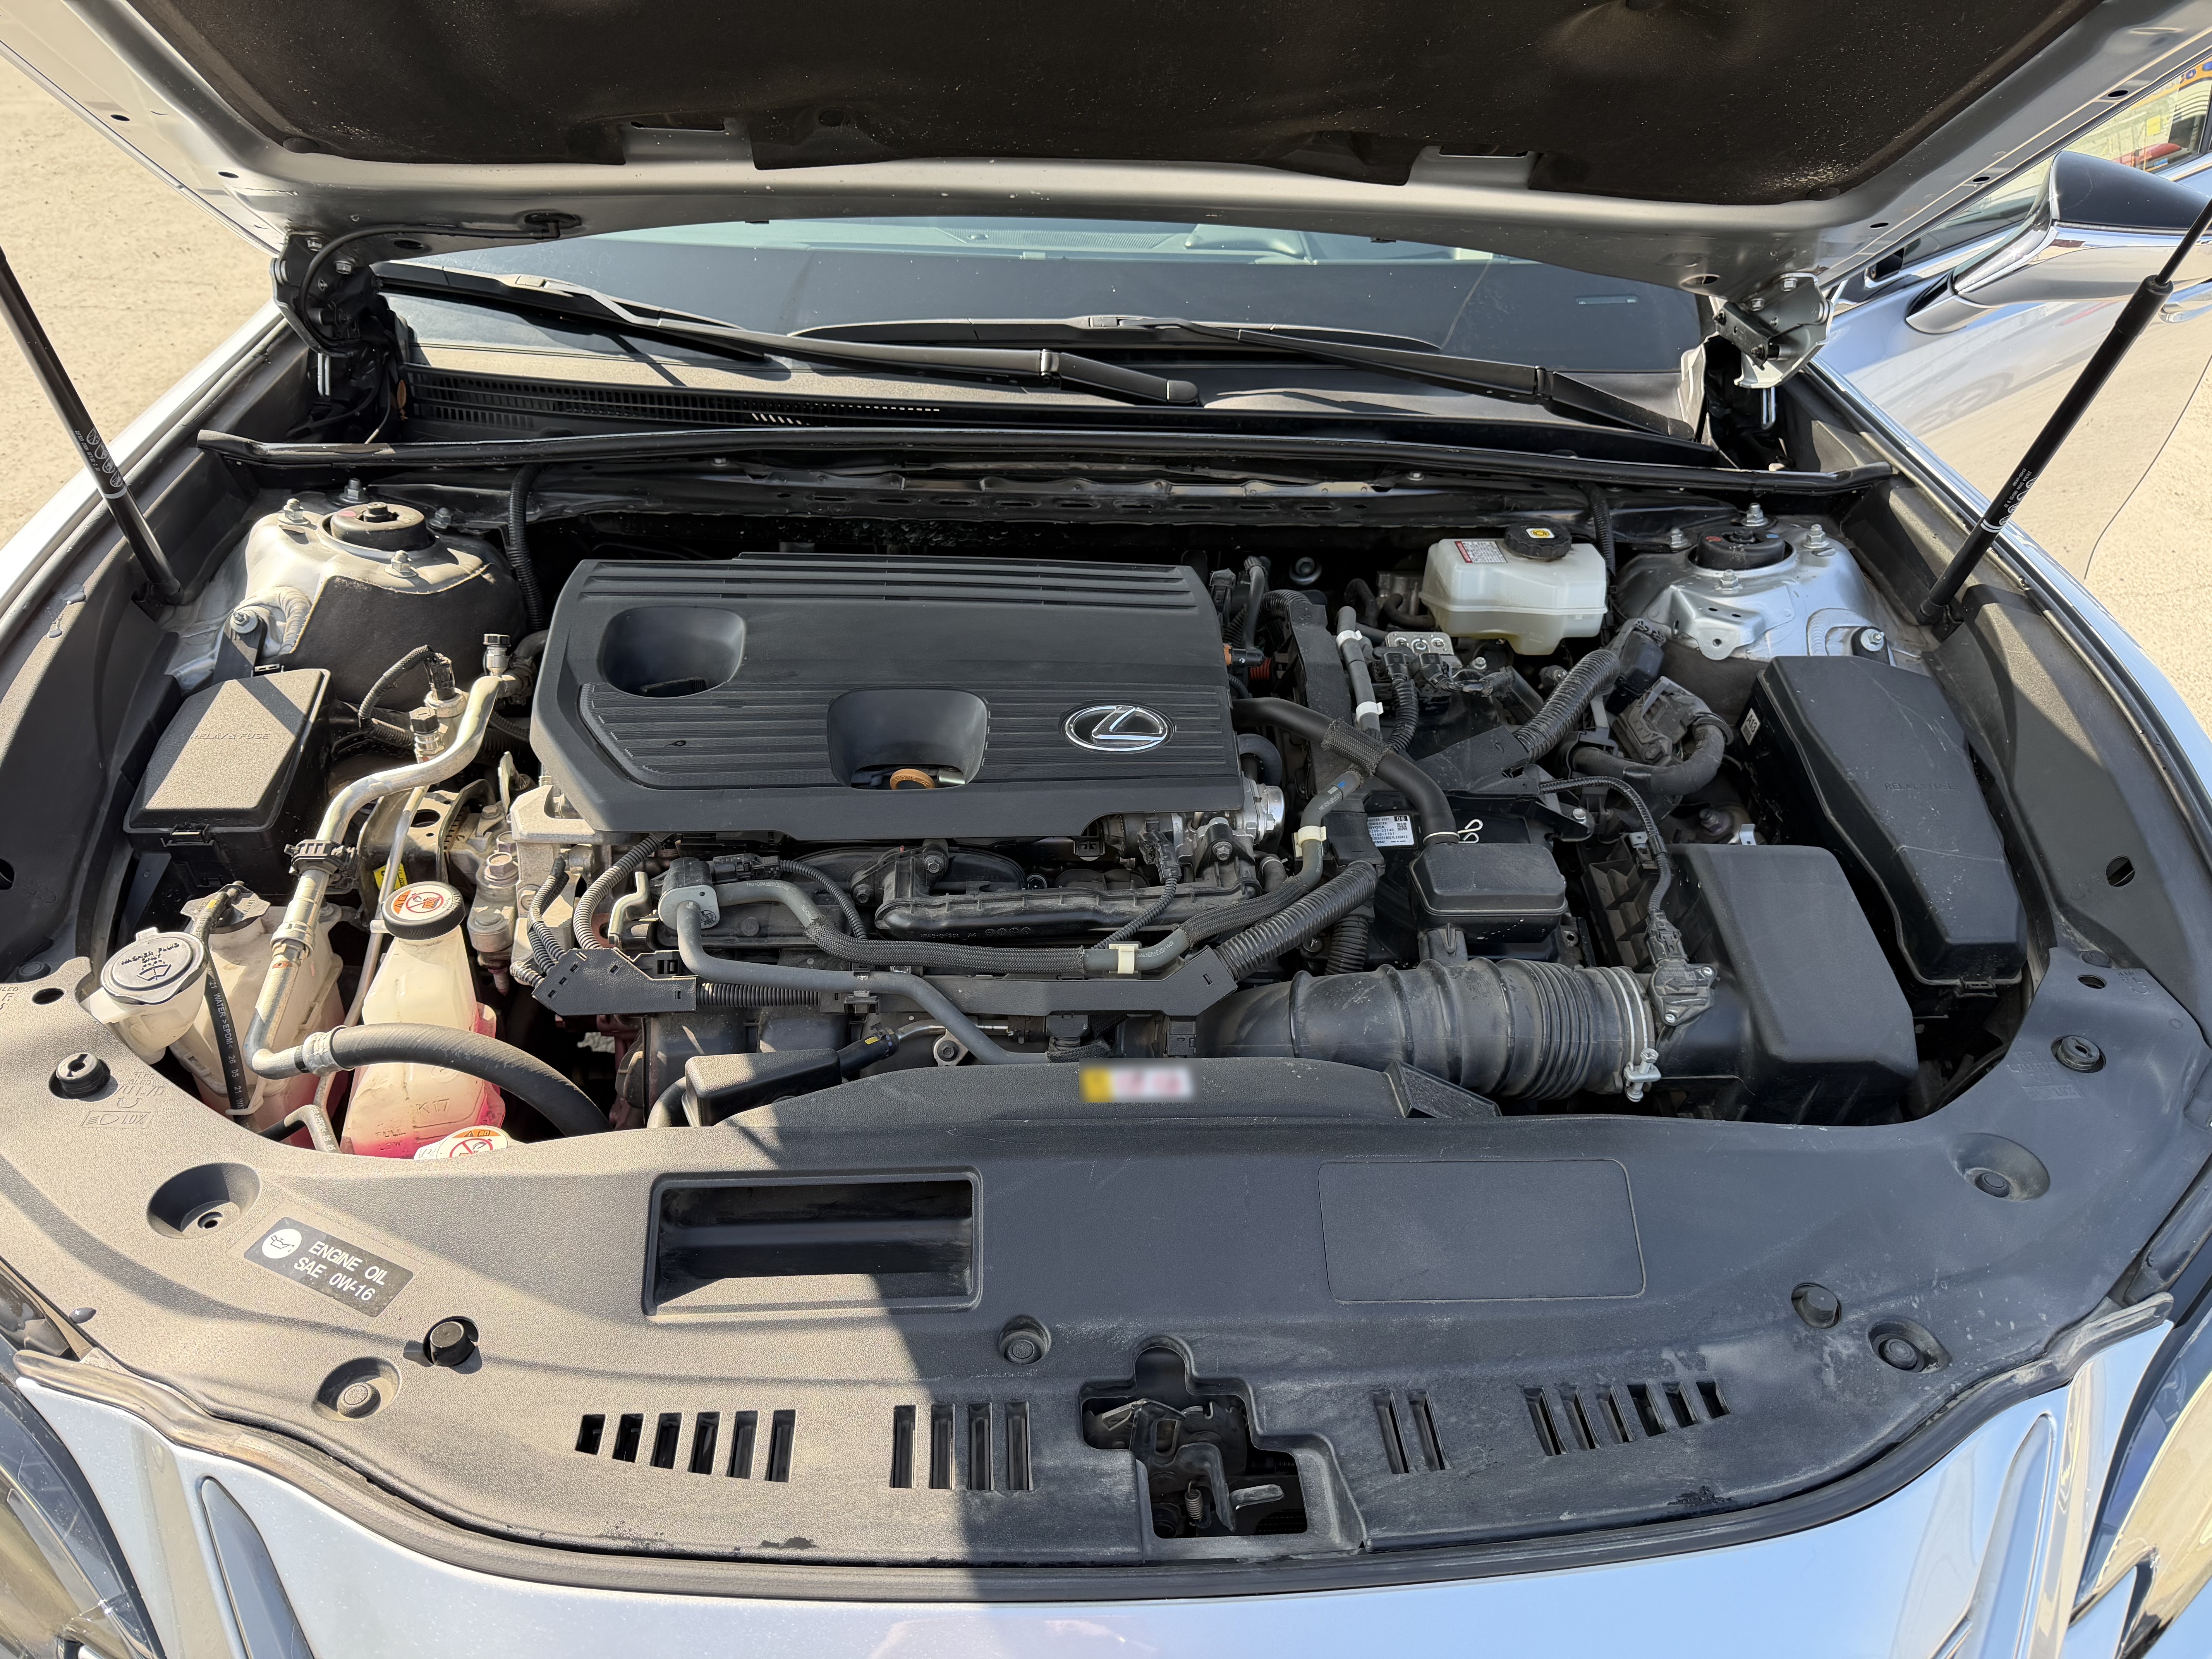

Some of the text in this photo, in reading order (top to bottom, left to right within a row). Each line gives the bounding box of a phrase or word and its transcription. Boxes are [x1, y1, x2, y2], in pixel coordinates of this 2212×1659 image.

[1746, 714, 1757, 733] A13
[120, 951, 154, 965] WASHER
[213, 993, 227, 1018] WATER
[222, 1019, 233, 1049] >EPDM<
[231, 1069, 239, 1078] 05
[375, 1128, 406, 1139] FULL
[380, 1140, 402, 1151] LOW
[309, 1241, 388, 1285] ENGINE OIL
[294, 1257, 376, 1301] SAE 0W-16
